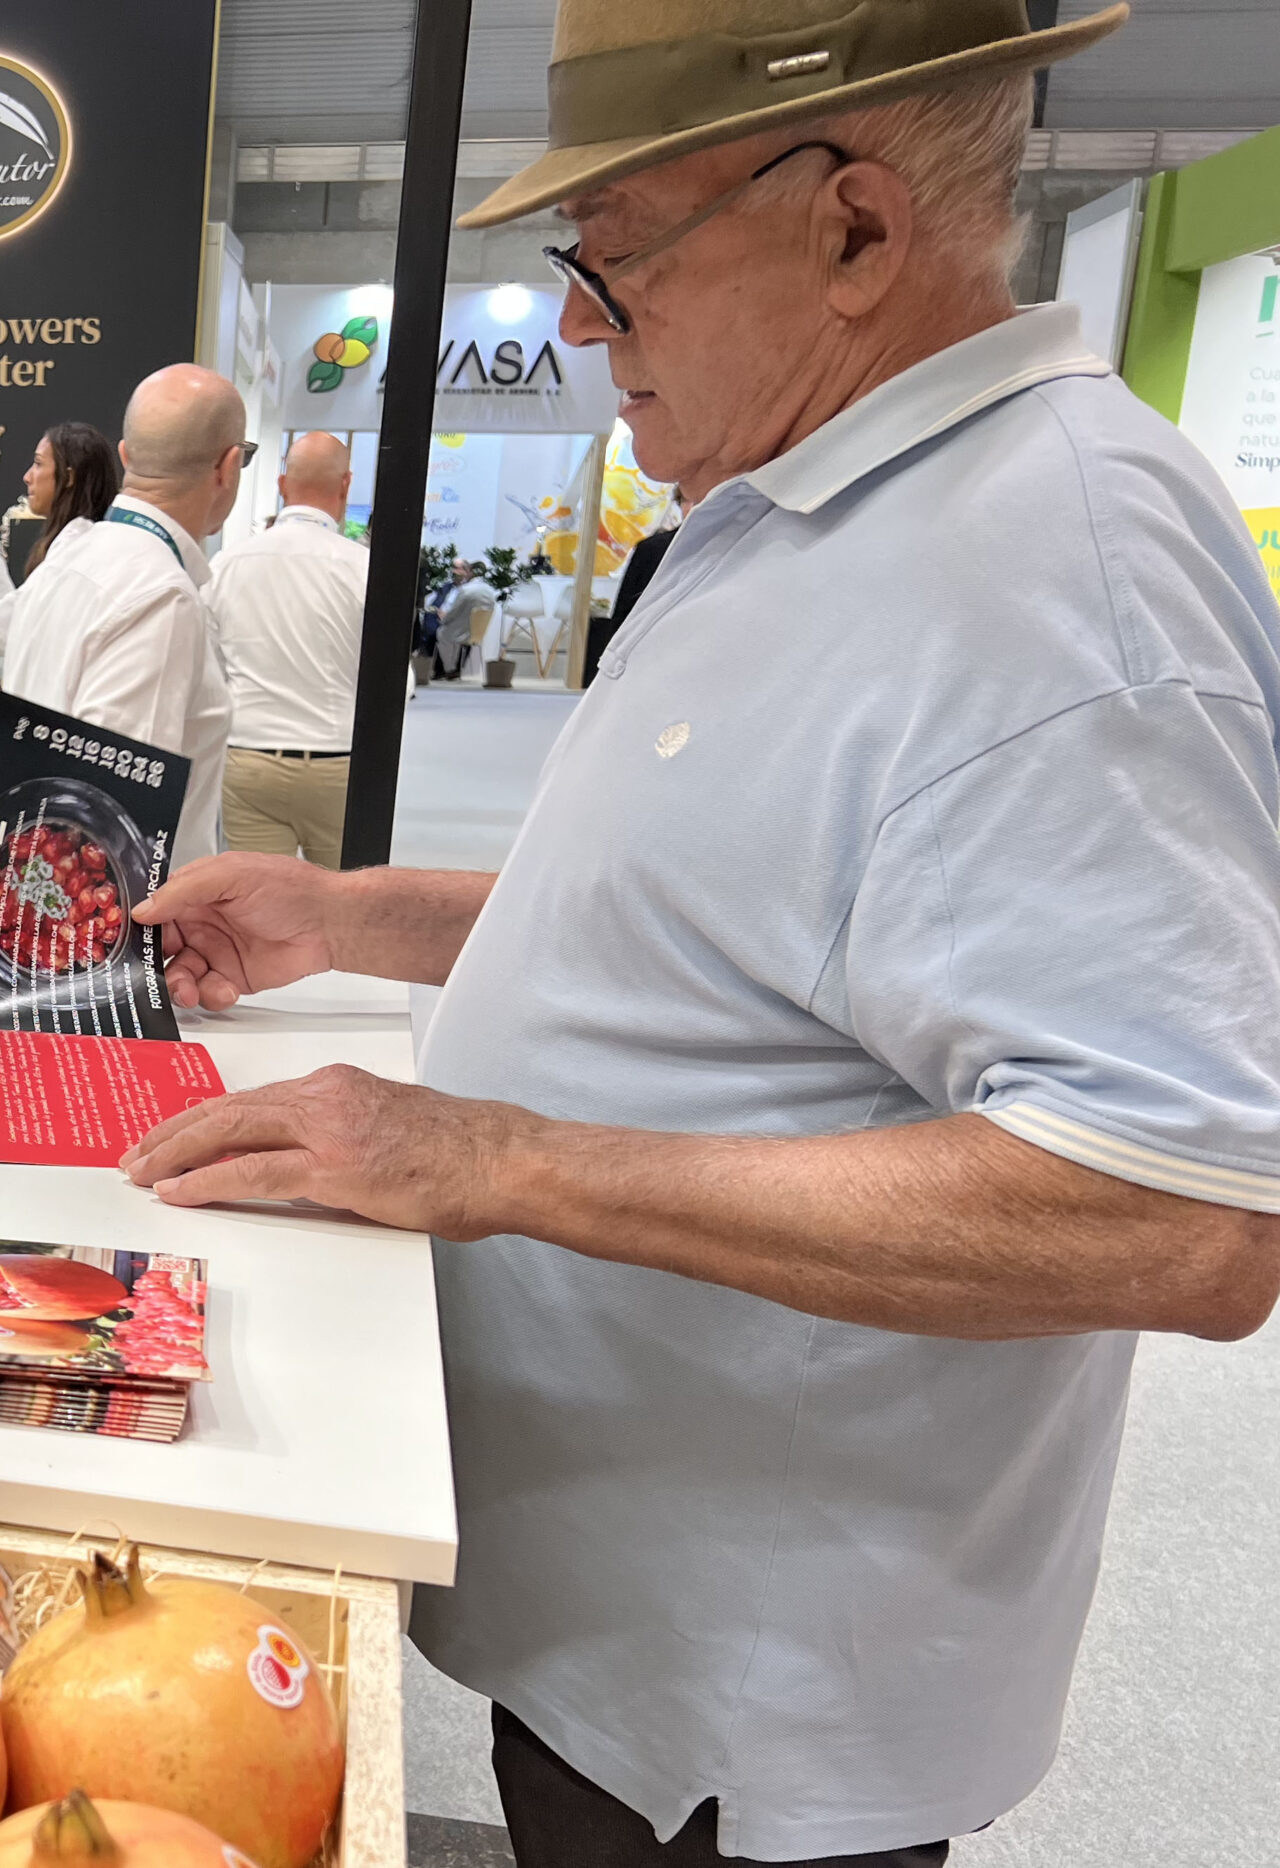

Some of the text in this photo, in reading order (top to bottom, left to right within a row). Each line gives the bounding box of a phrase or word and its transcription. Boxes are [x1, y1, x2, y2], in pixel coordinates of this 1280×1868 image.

[380, 340, 562, 385] VASA
[49, 728, 69, 752] 10
[66, 735, 86, 759] 12
[141, 829, 168, 1009] FOTOGRAFÍAS: IRE ARCÍA DÍAZ
